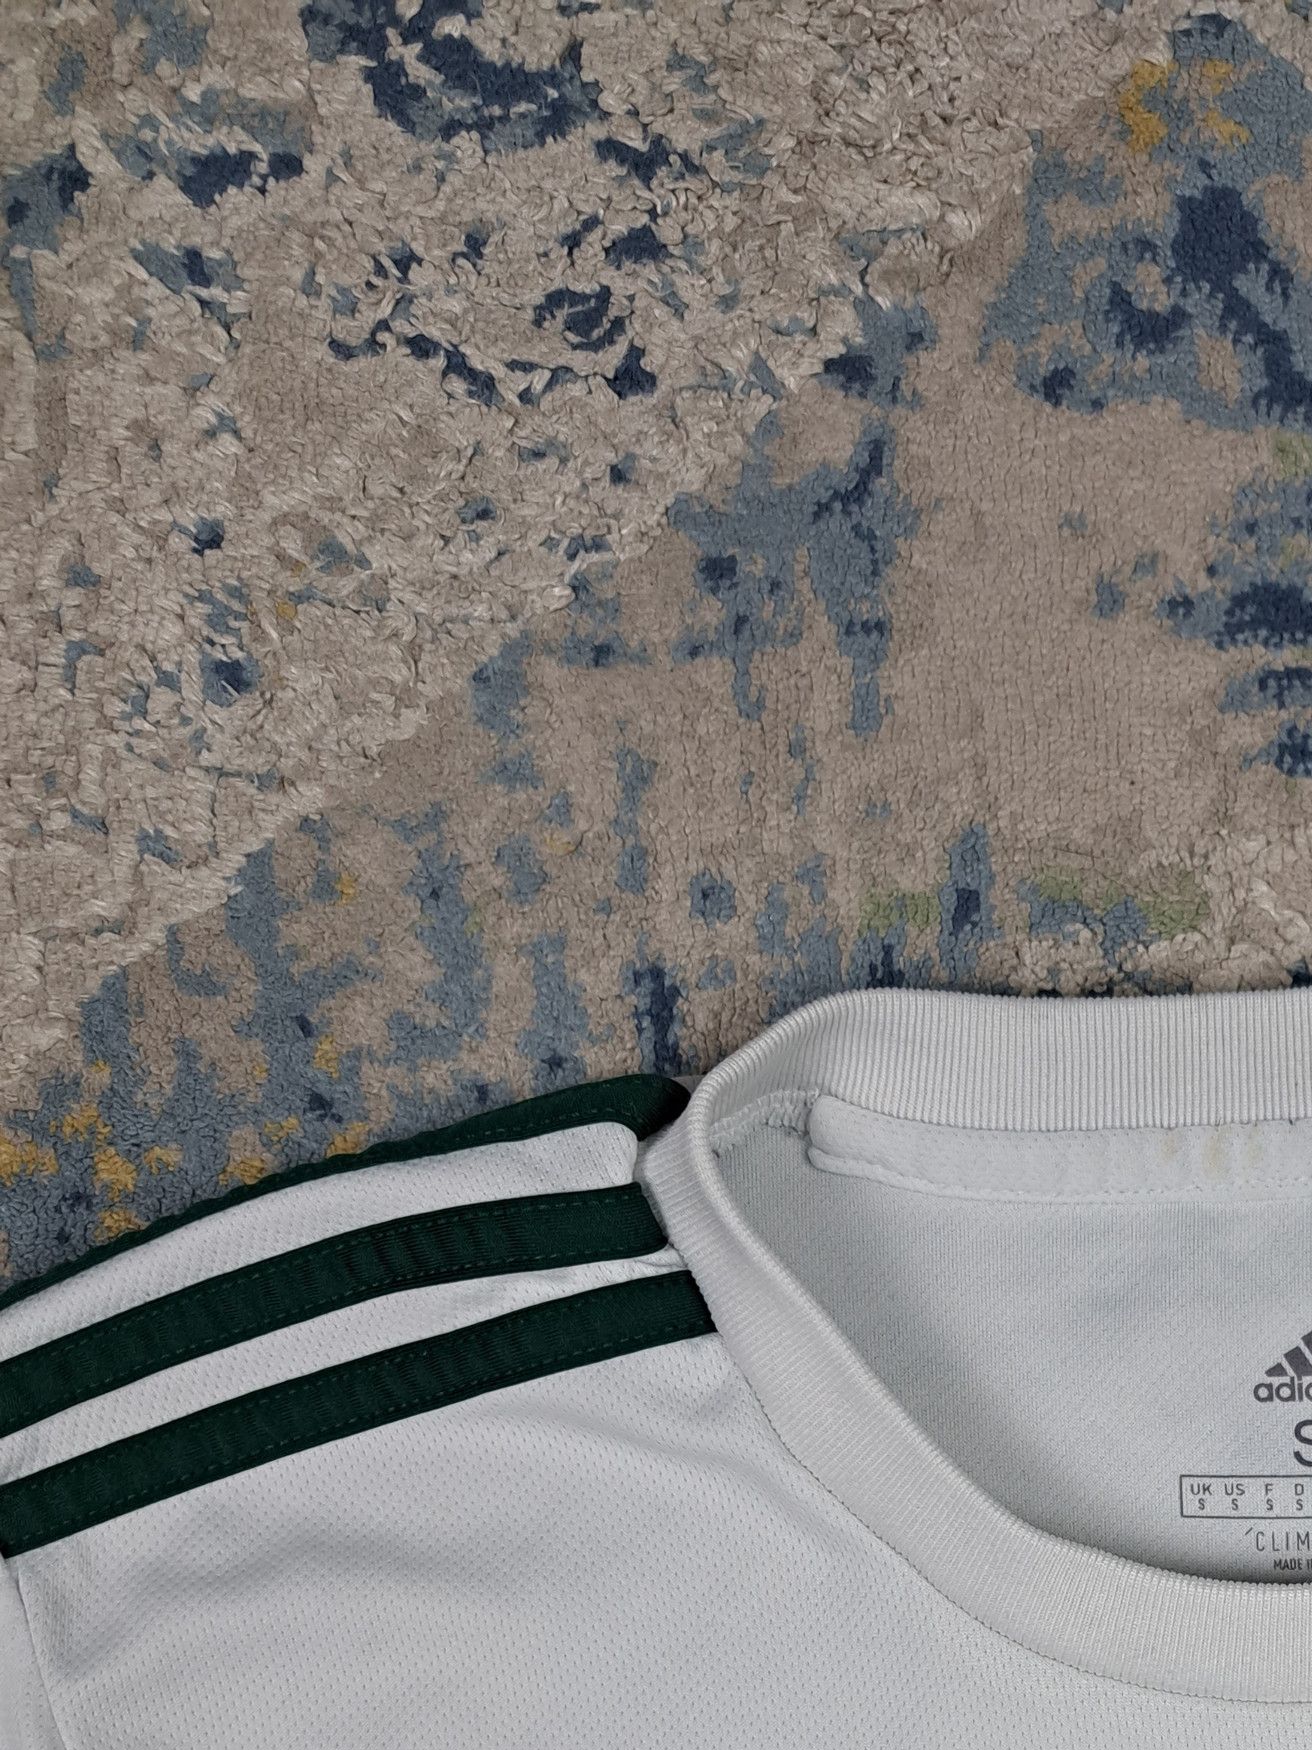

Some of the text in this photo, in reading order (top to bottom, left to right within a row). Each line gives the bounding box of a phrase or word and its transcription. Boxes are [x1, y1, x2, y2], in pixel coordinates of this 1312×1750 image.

[1190, 1483, 1212, 1496] UK
[1224, 1483, 1246, 1496] US
[1264, 1483, 1274, 1496] F
[1294, 1483, 1305, 1496] D
[1198, 1498, 1206, 1511] S
[1231, 1498, 1239, 1511] S
[1266, 1498, 1274, 1511] S
[1296, 1498, 1304, 1511] S
[1273, 1557, 1303, 1571] MADE
